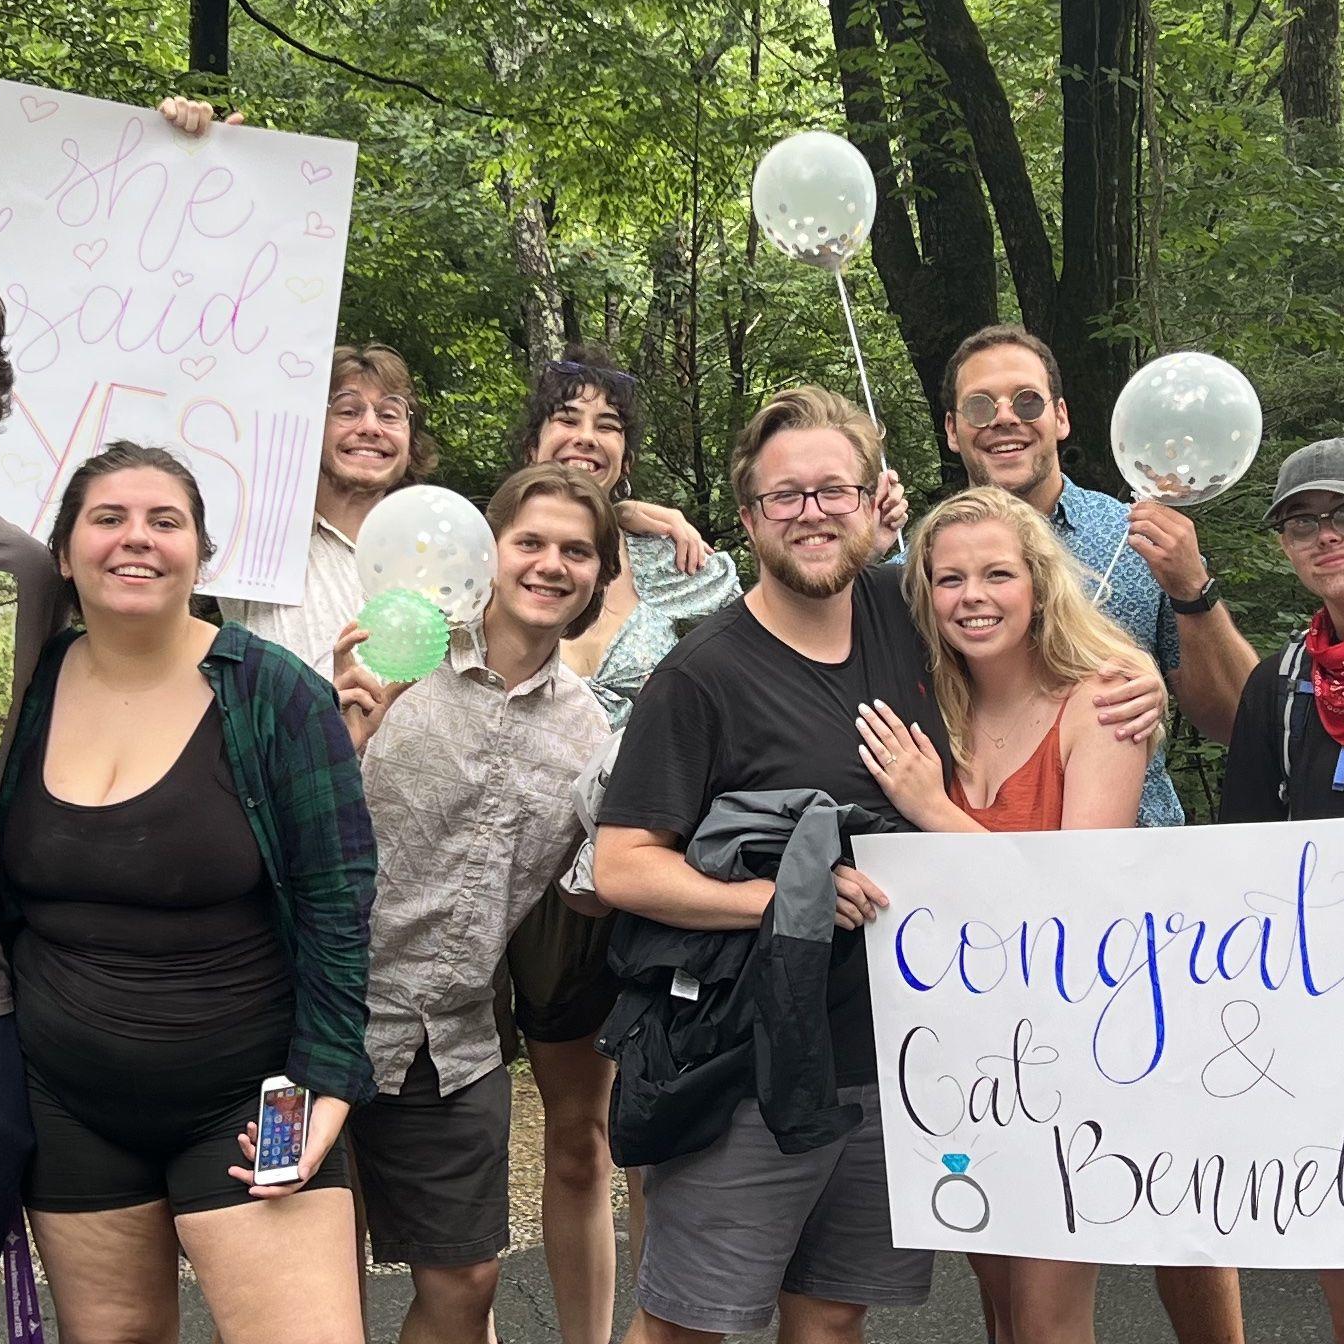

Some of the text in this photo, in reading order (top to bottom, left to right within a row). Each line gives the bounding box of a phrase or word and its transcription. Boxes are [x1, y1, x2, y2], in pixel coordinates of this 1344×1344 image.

[45, 116, 254, 272] she
[6, 241, 278, 374] said
[898, 999, 1296, 1137] Cat &
